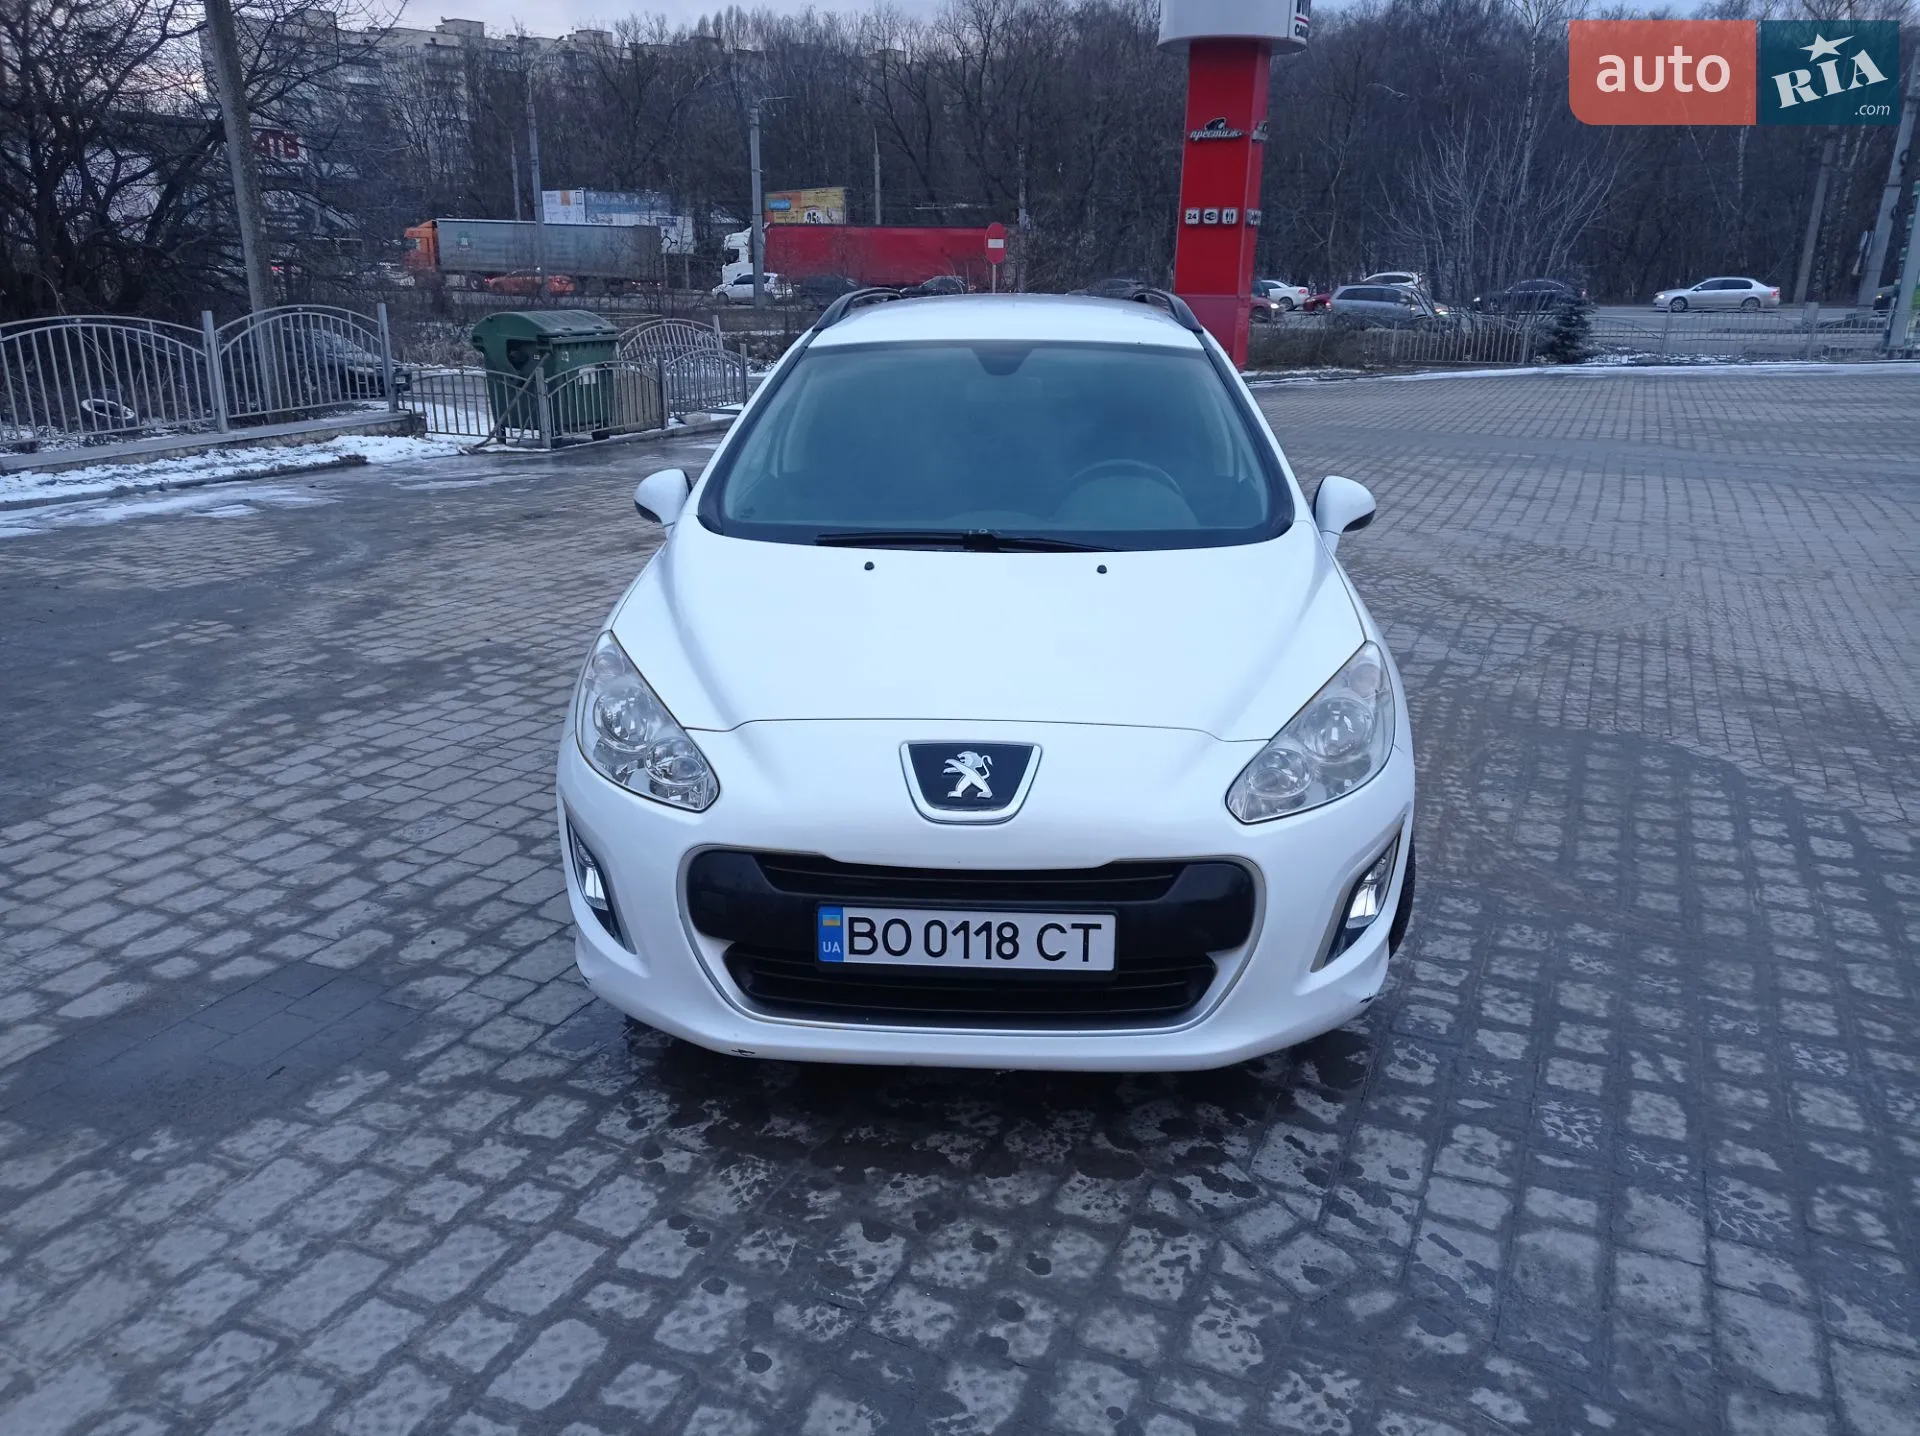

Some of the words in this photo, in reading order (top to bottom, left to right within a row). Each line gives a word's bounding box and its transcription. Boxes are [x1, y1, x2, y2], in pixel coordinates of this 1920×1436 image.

[822, 940, 841, 953] UA
[848, 916, 912, 957] BO
[923, 919, 1020, 961] 0118
[1036, 922, 1102, 962] CT
